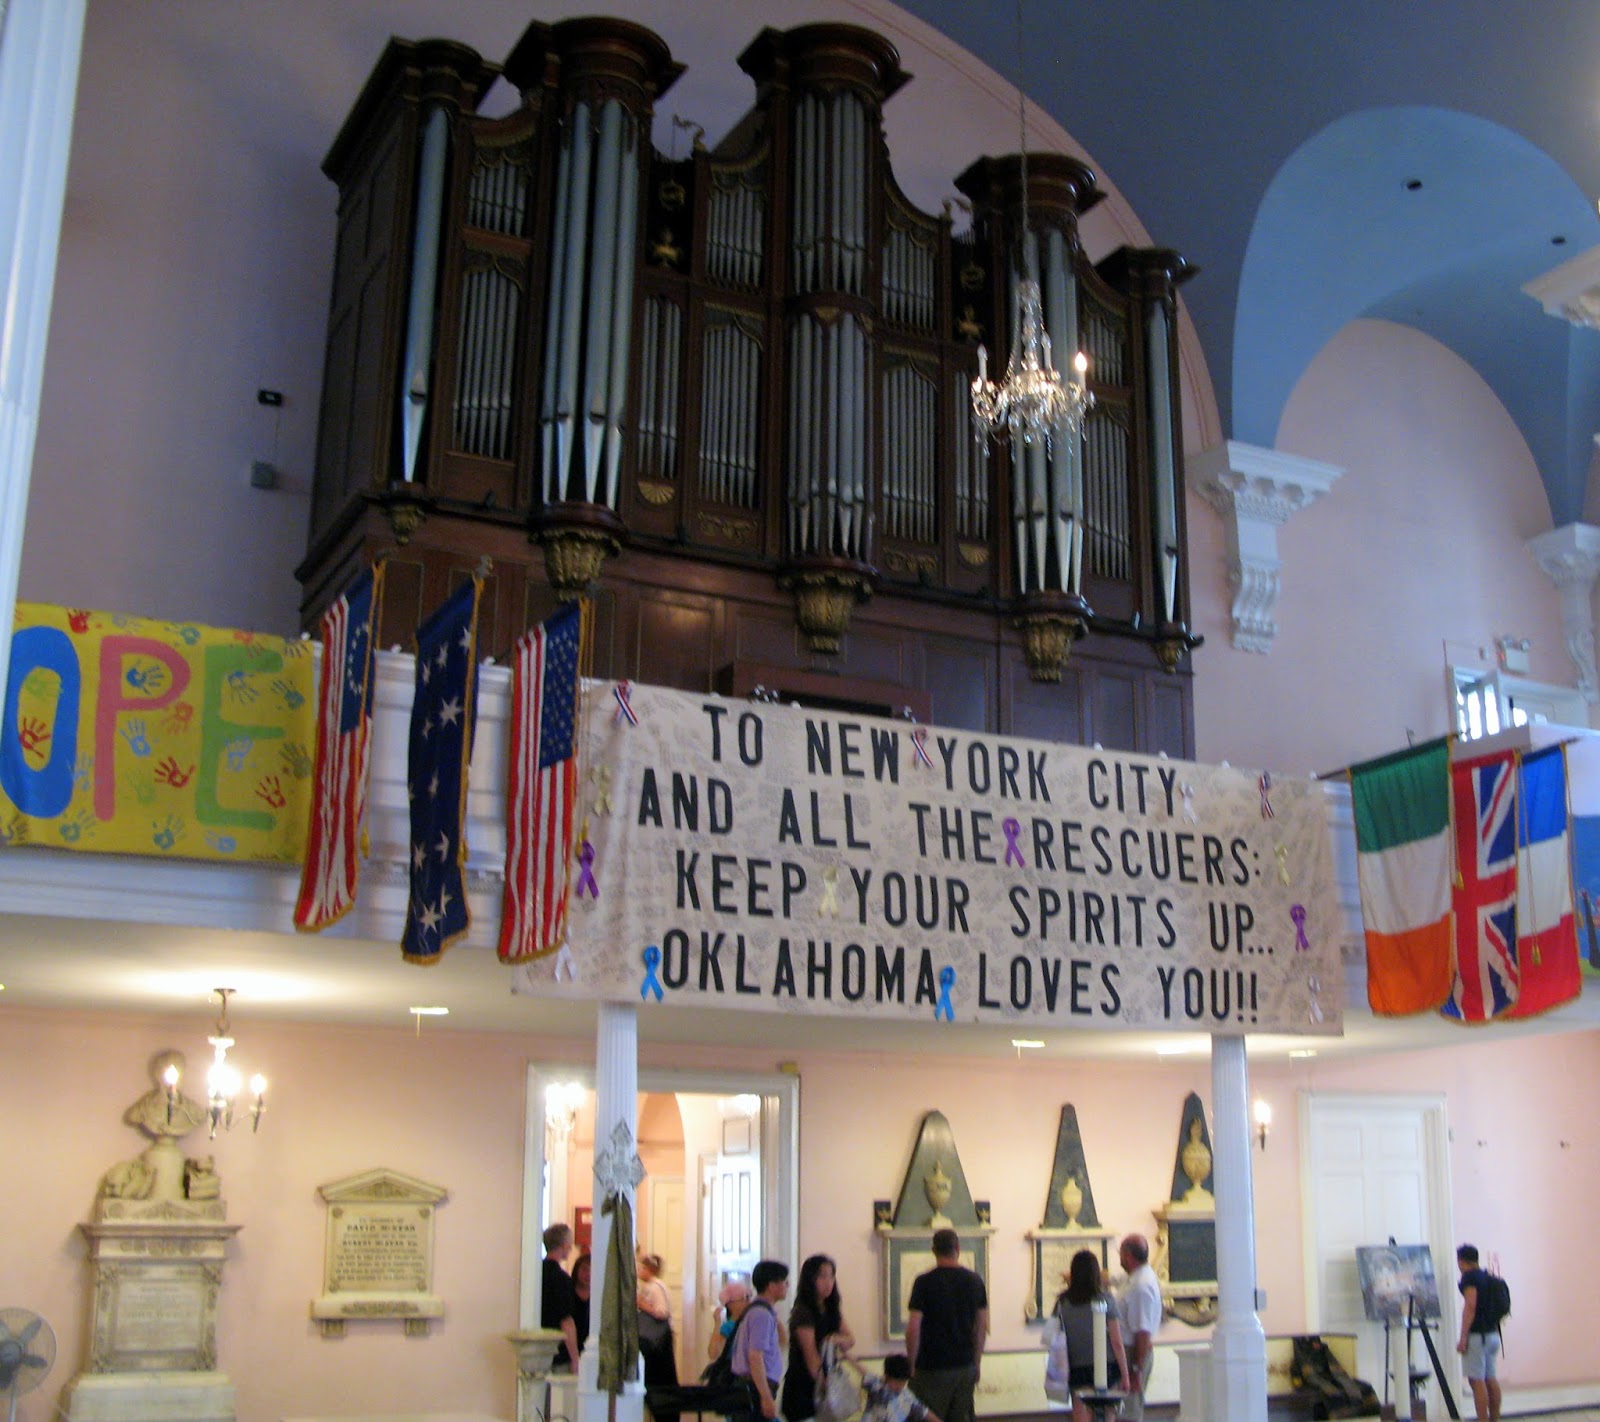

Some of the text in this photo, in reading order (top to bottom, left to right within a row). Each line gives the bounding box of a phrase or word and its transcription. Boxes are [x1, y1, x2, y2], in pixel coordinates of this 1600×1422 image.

[702, 704, 1176, 817] TO NEW YORK CITY
[637, 768, 1262, 887] AND ALL THE RESCUERS:
[676, 849, 1275, 955] KEEP YOUR SPIRITS UP...
[662, 928, 938, 1006] OKLAHOMA
[978, 952, 1121, 1016] LOVES
[1156, 967, 1258, 1023] YOU!!
